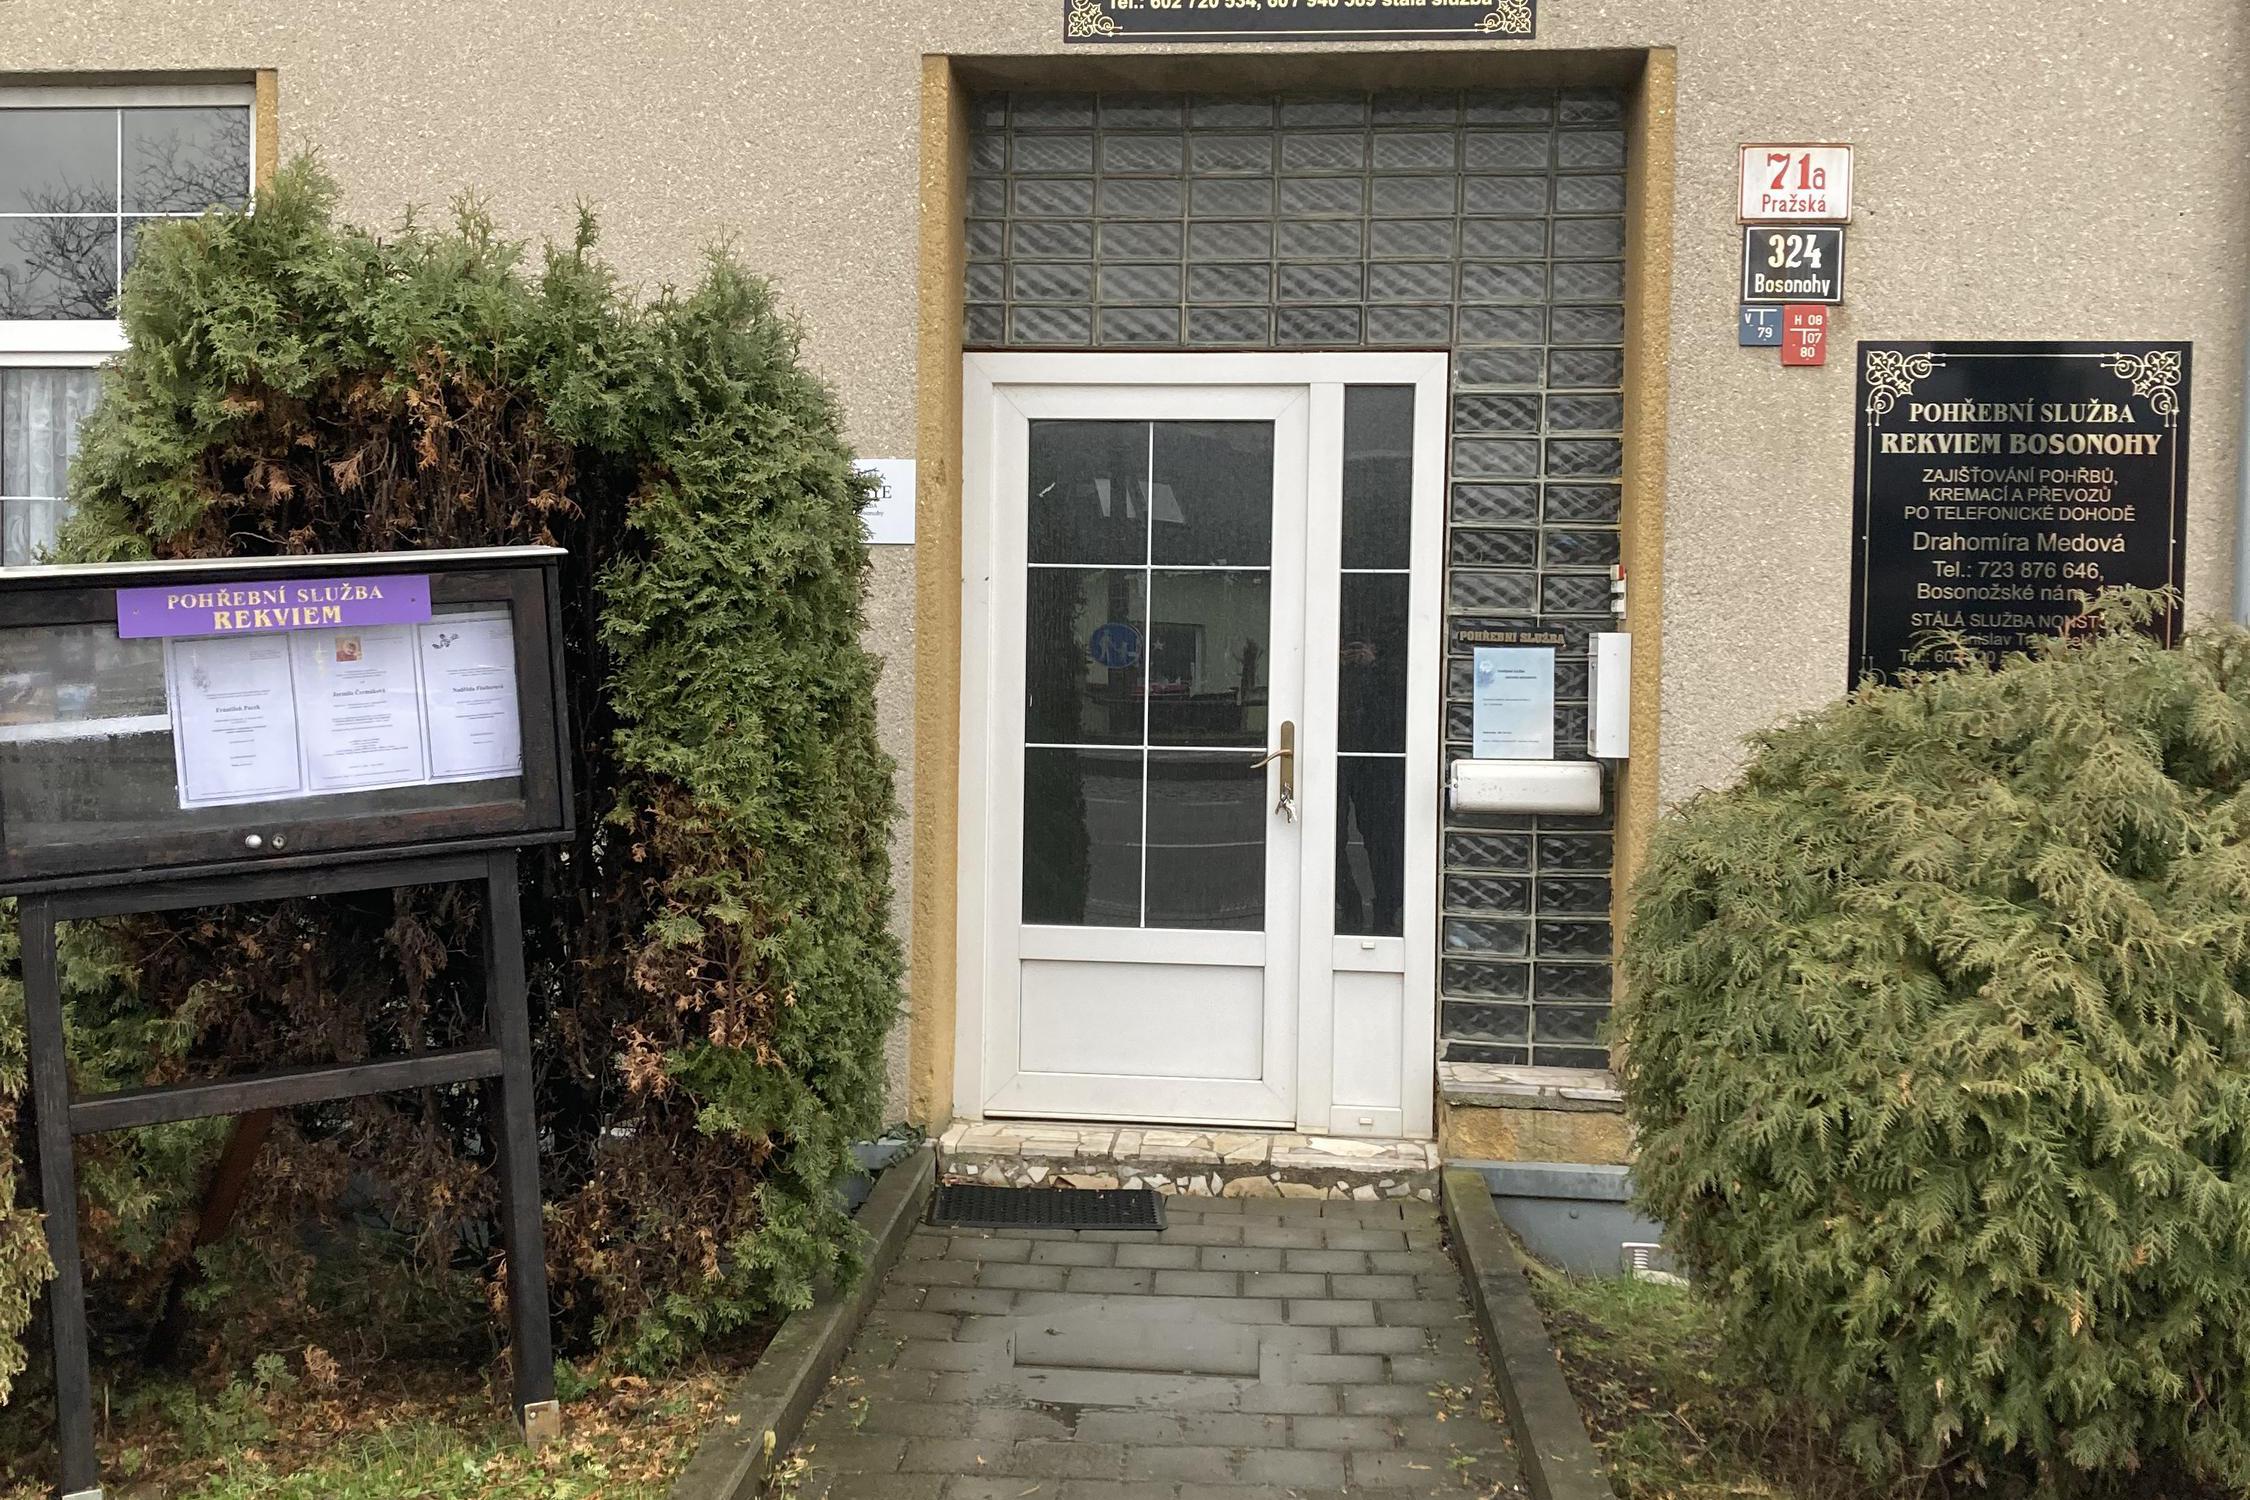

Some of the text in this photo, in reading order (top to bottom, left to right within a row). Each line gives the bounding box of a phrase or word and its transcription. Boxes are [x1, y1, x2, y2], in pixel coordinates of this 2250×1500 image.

[1767, 153, 1826, 190] 71a
[1762, 194, 1826, 213] Pražská
[1768, 234, 1822, 269] 324
[1755, 273, 1831, 297] Bosonohy
[1794, 314, 1823, 326] H 08
[1757, 327, 1773, 338] 79
[1800, 347, 1815, 358] 80
[1909, 397, 2136, 423] POHŘEBNÍ SLUŽBA
[1880, 433, 2162, 455] REKVIEM BOSONOHY
[1922, 466, 2118, 485] ZAJIŠŤOVÁNÍ POHŘBŮ,
[1929, 485, 2111, 503] KREMACÍ A PŘEVOZŮ
[1904, 504, 2136, 521] PO TELEFONICKÉ DOHODĚ
[1913, 531, 2125, 552] Drahomíra Medová
[1932, 560, 2104, 581] Tel.: 723 876 646,
[167, 583, 384, 610] POHŘEBNÍ SLUŽBA
[1917, 581, 2034, 601] Bosonožské
[213, 606, 342, 630] REKVIEM
[1911, 612, 1966, 627] STÁLÁ
[1970, 612, 2036, 629] SLUŽBA
